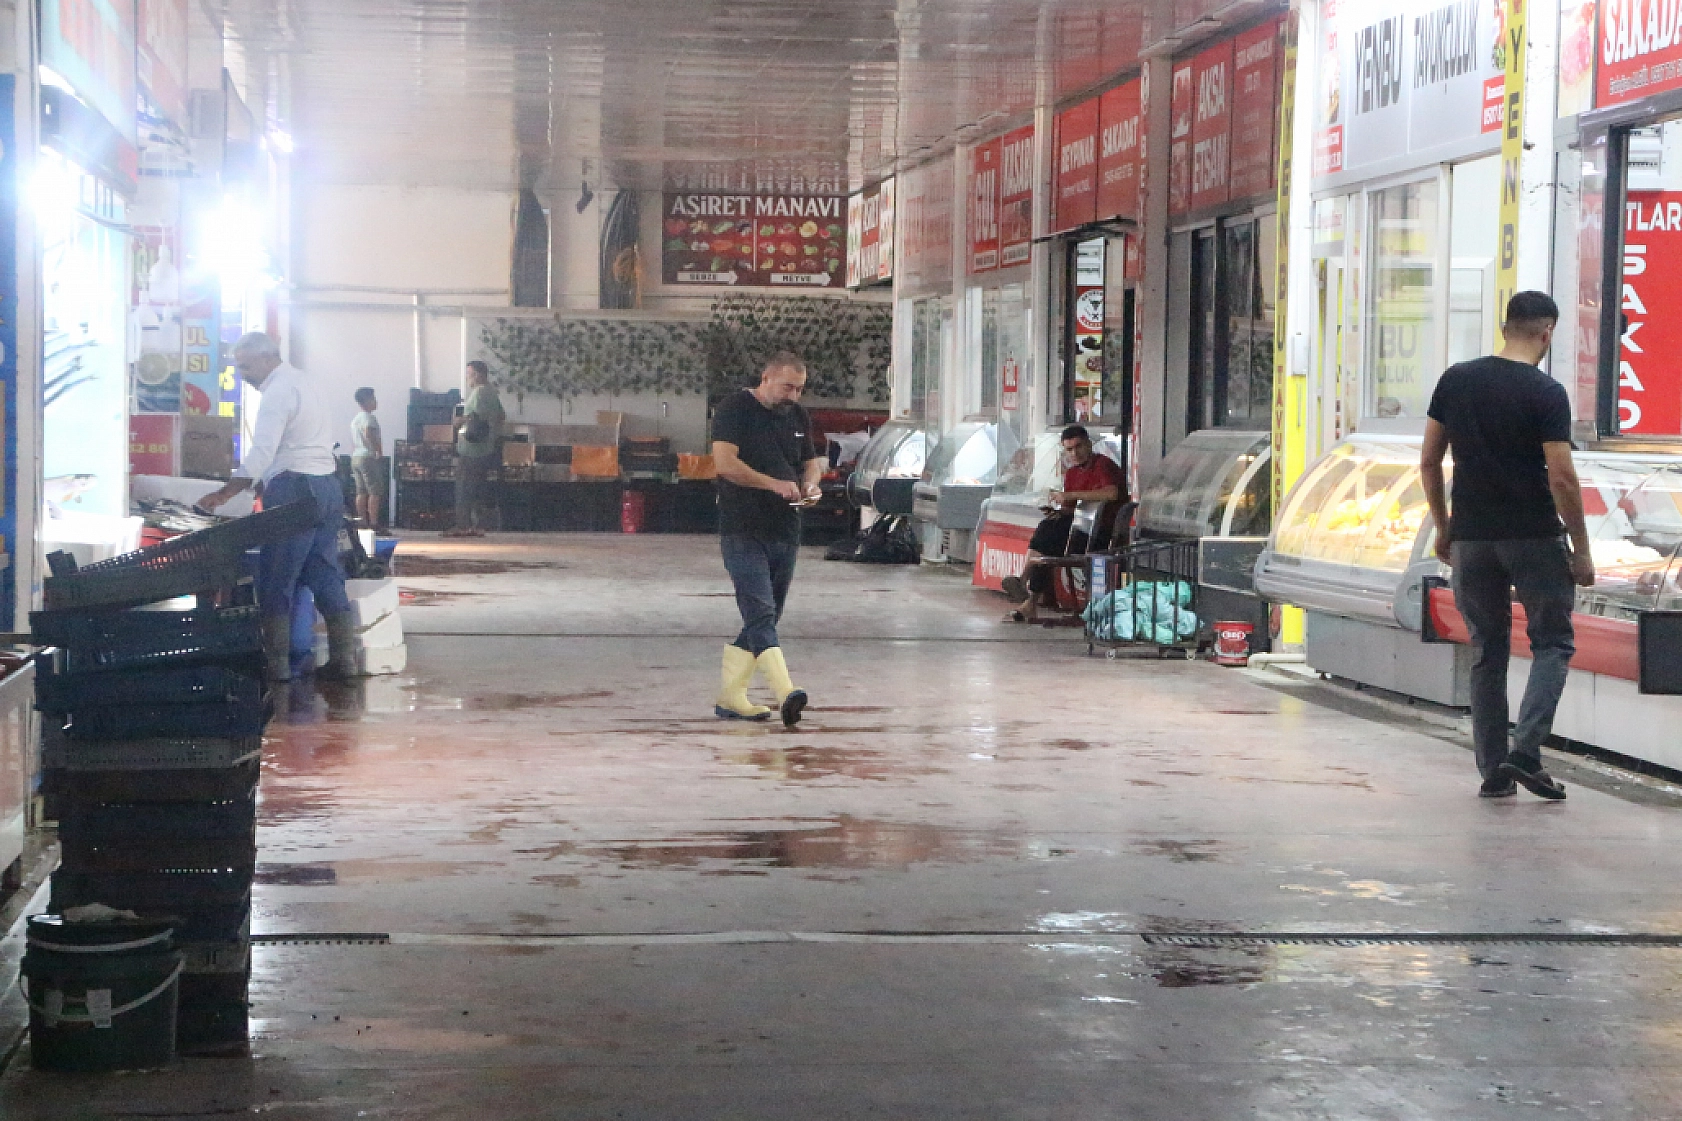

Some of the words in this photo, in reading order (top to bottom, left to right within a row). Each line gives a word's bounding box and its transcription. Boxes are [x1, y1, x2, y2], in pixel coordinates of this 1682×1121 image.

[1354, 13, 1404, 116] YENBU
[755, 196, 840, 217] MANAVI
[1626, 201, 1682, 231] TLAR
